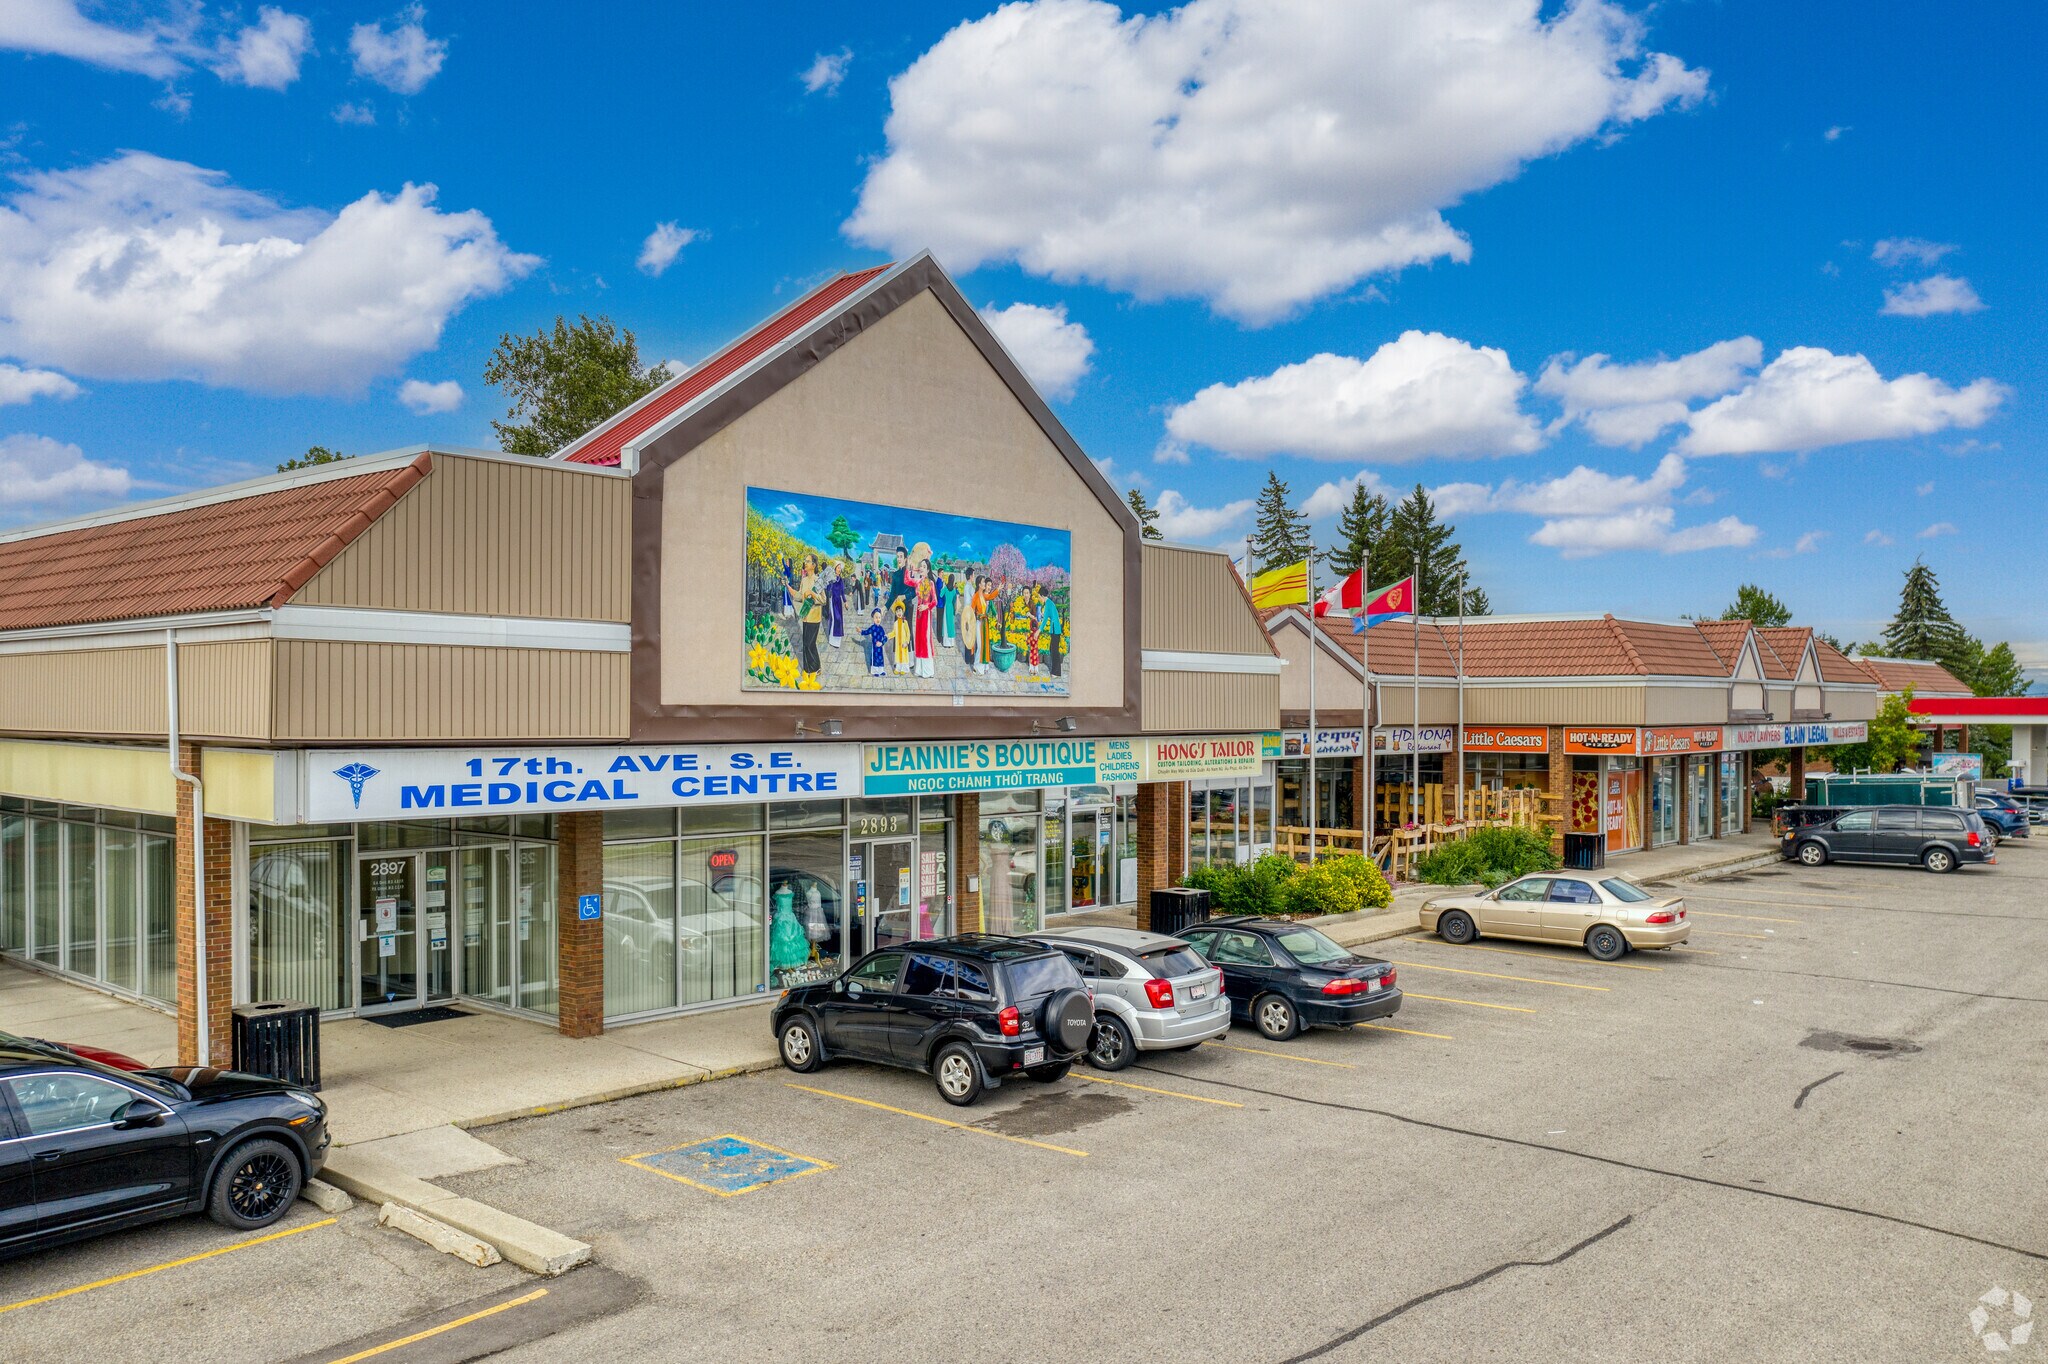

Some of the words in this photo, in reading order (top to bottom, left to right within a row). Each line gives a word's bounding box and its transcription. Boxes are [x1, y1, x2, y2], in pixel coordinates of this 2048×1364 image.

[1462, 731, 1494, 746] Little
[1495, 732, 1543, 747] Caesars
[1569, 732, 1634, 744] HOT-N-READY
[1738, 730, 1756, 743] INJURY
[1757, 729, 1781, 742] LAWYERS
[1784, 726, 1806, 744] BLAIN
[1807, 725, 1829, 742] LEGAL
[1108, 741, 1130, 750] MENS
[1157, 743, 1207, 760] HONG'S
[1210, 740, 1255, 758] TAILOR
[1653, 735, 1668, 752] Little
[1669, 734, 1690, 750] Caesars
[871, 743, 990, 772] JEANNIE'S
[995, 741, 1096, 767] BOUTIQUE
[1106, 752, 1133, 760] LADIES
[1204, 758, 1233, 766] ALTERATIONS
[466, 757, 583, 777] 17th.
[607, 754, 711, 773] AVE.
[730, 752, 801, 769] S.E.
[1100, 762, 1140, 772] CHILDRENS
[908, 777, 945, 792] NGỌC
[1026, 772, 1064, 784] TRANG
[1102, 773, 1138, 782] FASHIONS
[401, 779, 639, 809] MEDICAL
[671, 771, 838, 797] CENTRE
[860, 816, 897, 834] 2893
[711, 854, 735, 867] OPEN
[921, 853, 936, 864] SALE
[370, 861, 406, 876] 2897
[921, 864, 936, 875] SALE
[936, 851, 946, 895] SALE
[921, 874, 936, 886] SALE
[921, 886, 936, 898] SALE
